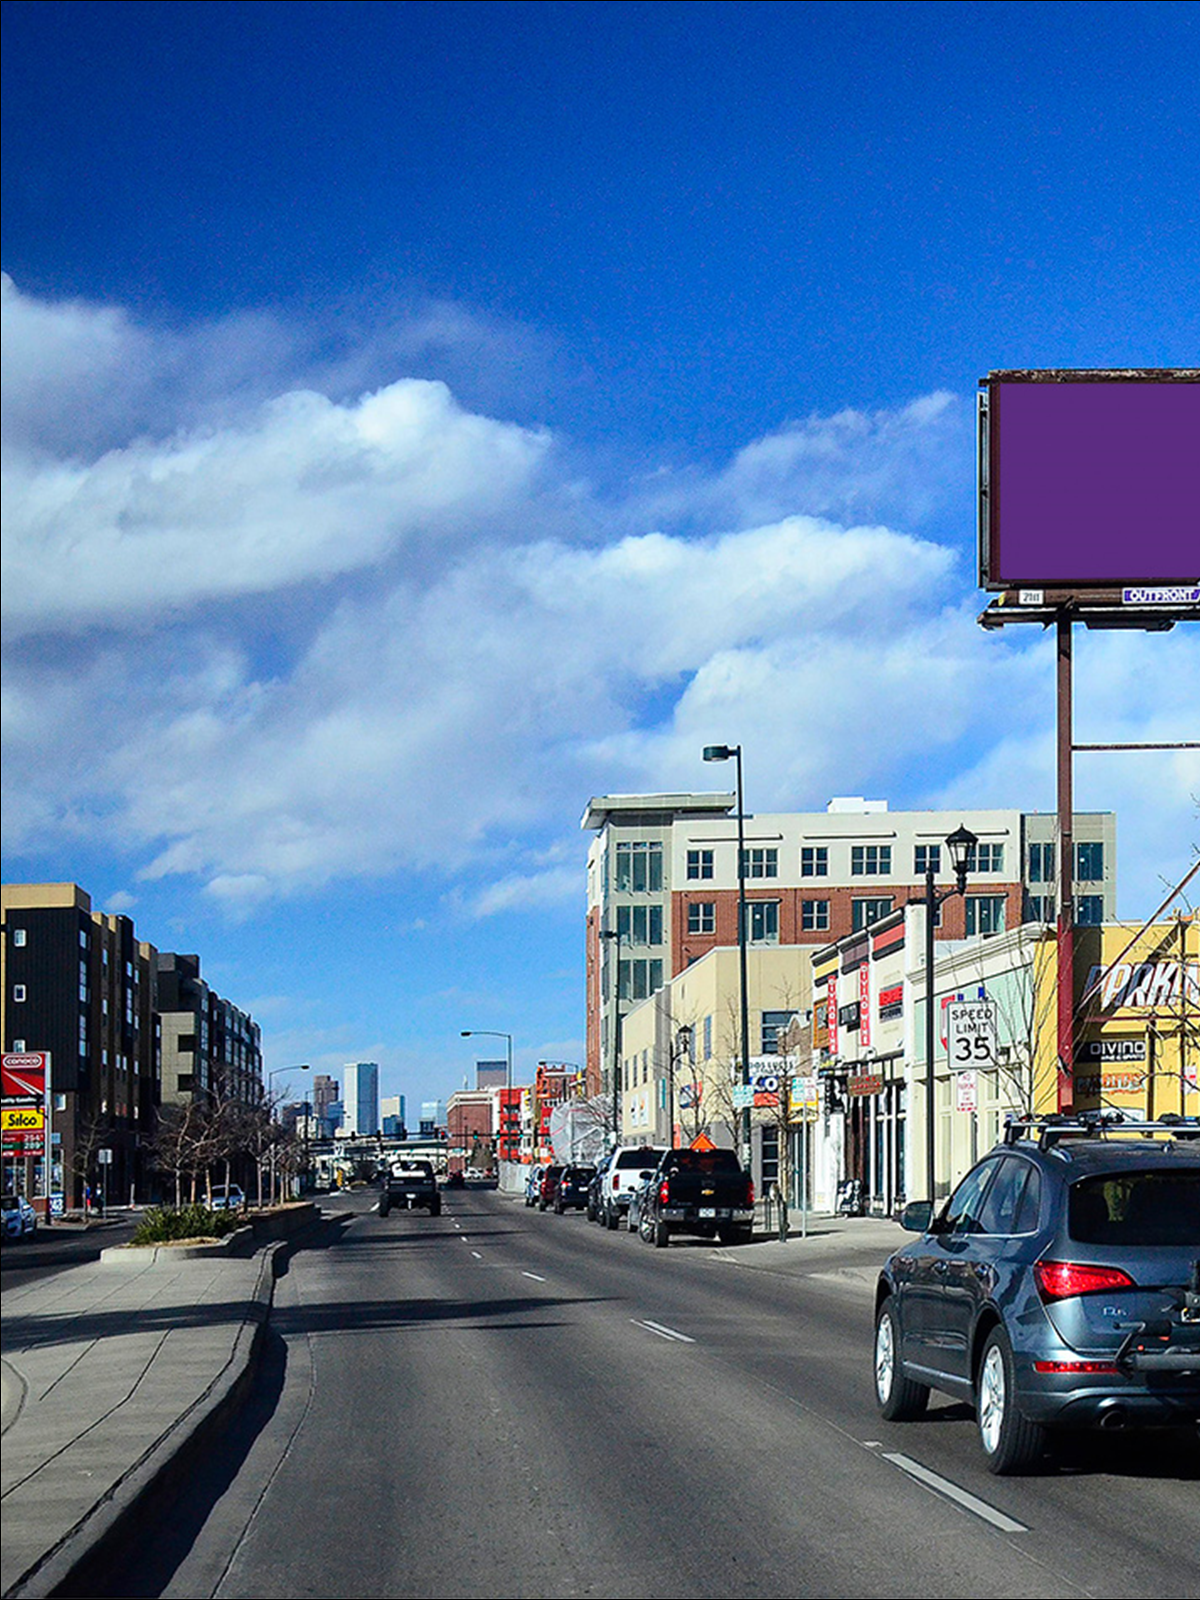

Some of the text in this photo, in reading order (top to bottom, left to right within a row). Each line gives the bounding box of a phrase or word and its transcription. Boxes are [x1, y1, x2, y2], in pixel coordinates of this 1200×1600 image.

[1129, 590, 1192, 601] OUTFRONT
[951, 1009, 993, 1020] SPEED
[956, 1023, 988, 1034] LIMIT
[955, 1037, 990, 1061] 35
[1090, 1041, 1146, 1055] DIVINO
[6, 1057, 40, 1066] conoco
[8, 1113, 37, 1126] Silco
